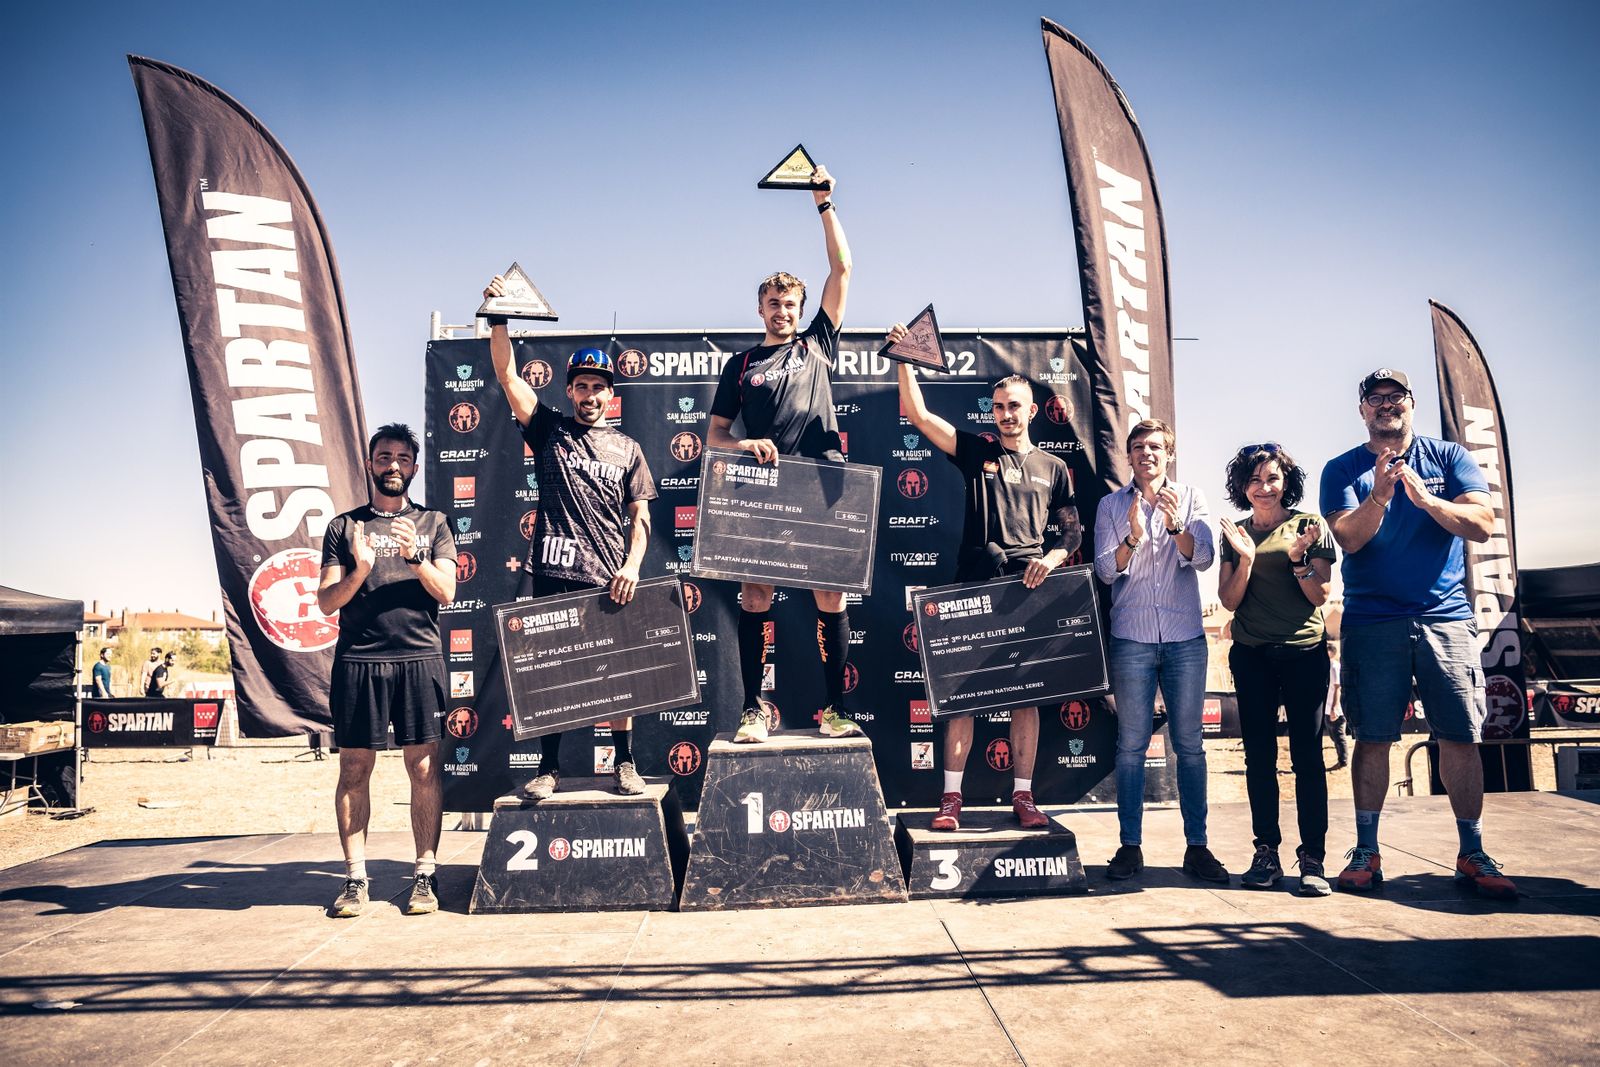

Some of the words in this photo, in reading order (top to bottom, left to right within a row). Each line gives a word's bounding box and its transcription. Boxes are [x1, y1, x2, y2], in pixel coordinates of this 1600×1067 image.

[1095, 160, 1149, 436] ARTAN
[202, 191, 336, 541] SPARTAN
[650, 352, 741, 376] SPARTA
[1053, 372, 1077, 380] AGUSTÍN
[444, 380, 457, 388] SAN
[459, 378, 484, 388] AGUSTÍN
[681, 411, 706, 420] AGUSTÍN
[980, 412, 994, 420] AGUS
[1038, 441, 1075, 450] CRAFT
[440, 450, 478, 459] CRAFT
[906, 449, 931, 457] AGUSTÍN
[567, 451, 625, 484] SPARTAN
[726, 463, 769, 479] SPARTAN
[770, 469, 778, 477] 20
[661, 478, 700, 486] CRAFT
[769, 477, 777, 486] 22
[740, 501, 762, 509] PLACE
[764, 503, 784, 511] ELITE
[889, 516, 928, 525] CRAFT
[374, 534, 429, 547] SPAAN
[458, 531, 481, 541] AGUSTÍN
[541, 535, 577, 567] 105
[890, 552, 937, 565] myzone
[759, 560, 788, 568] NATIONAL
[937, 597, 980, 613] SPARTAN
[982, 595, 991, 604] 20
[983, 604, 992, 613] 22
[522, 610, 568, 628] SPARTAN
[569, 608, 578, 617] 20
[570, 617, 580, 627] 22
[696, 634, 716, 642] Roja
[962, 632, 985, 641] PLACE
[987, 629, 1007, 637] ELITE
[1008, 626, 1025, 634] MEN
[549, 646, 572, 655] PLACE
[574, 641, 594, 650] ELITE
[596, 638, 614, 647] MEN
[534, 660, 562, 669] HUNDRED
[895, 671, 925, 679] CRA
[949, 693, 976, 701] SPARTAN
[976, 689, 994, 697] SPAIN
[995, 685, 1024, 693] NATIONAL
[534, 708, 562, 717] SPARTAN
[582, 698, 612, 707] NATIONAL
[613, 693, 632, 701] SERIES
[660, 711, 707, 724] myzone
[855, 713, 874, 721] Roja
[108, 713, 174, 732] SPARTAN
[509, 754, 543, 762] NIRVA
[1071, 755, 1096, 763] AGUSTÍN
[456, 763, 478, 771] AGUSTÍN
[740, 792, 764, 833] 1
[792, 809, 865, 830] SPARTAN
[506, 830, 538, 871] 2
[572, 838, 645, 858] SPARTAN
[929, 850, 962, 890] 3
[994, 857, 1068, 877] SPARTAN
